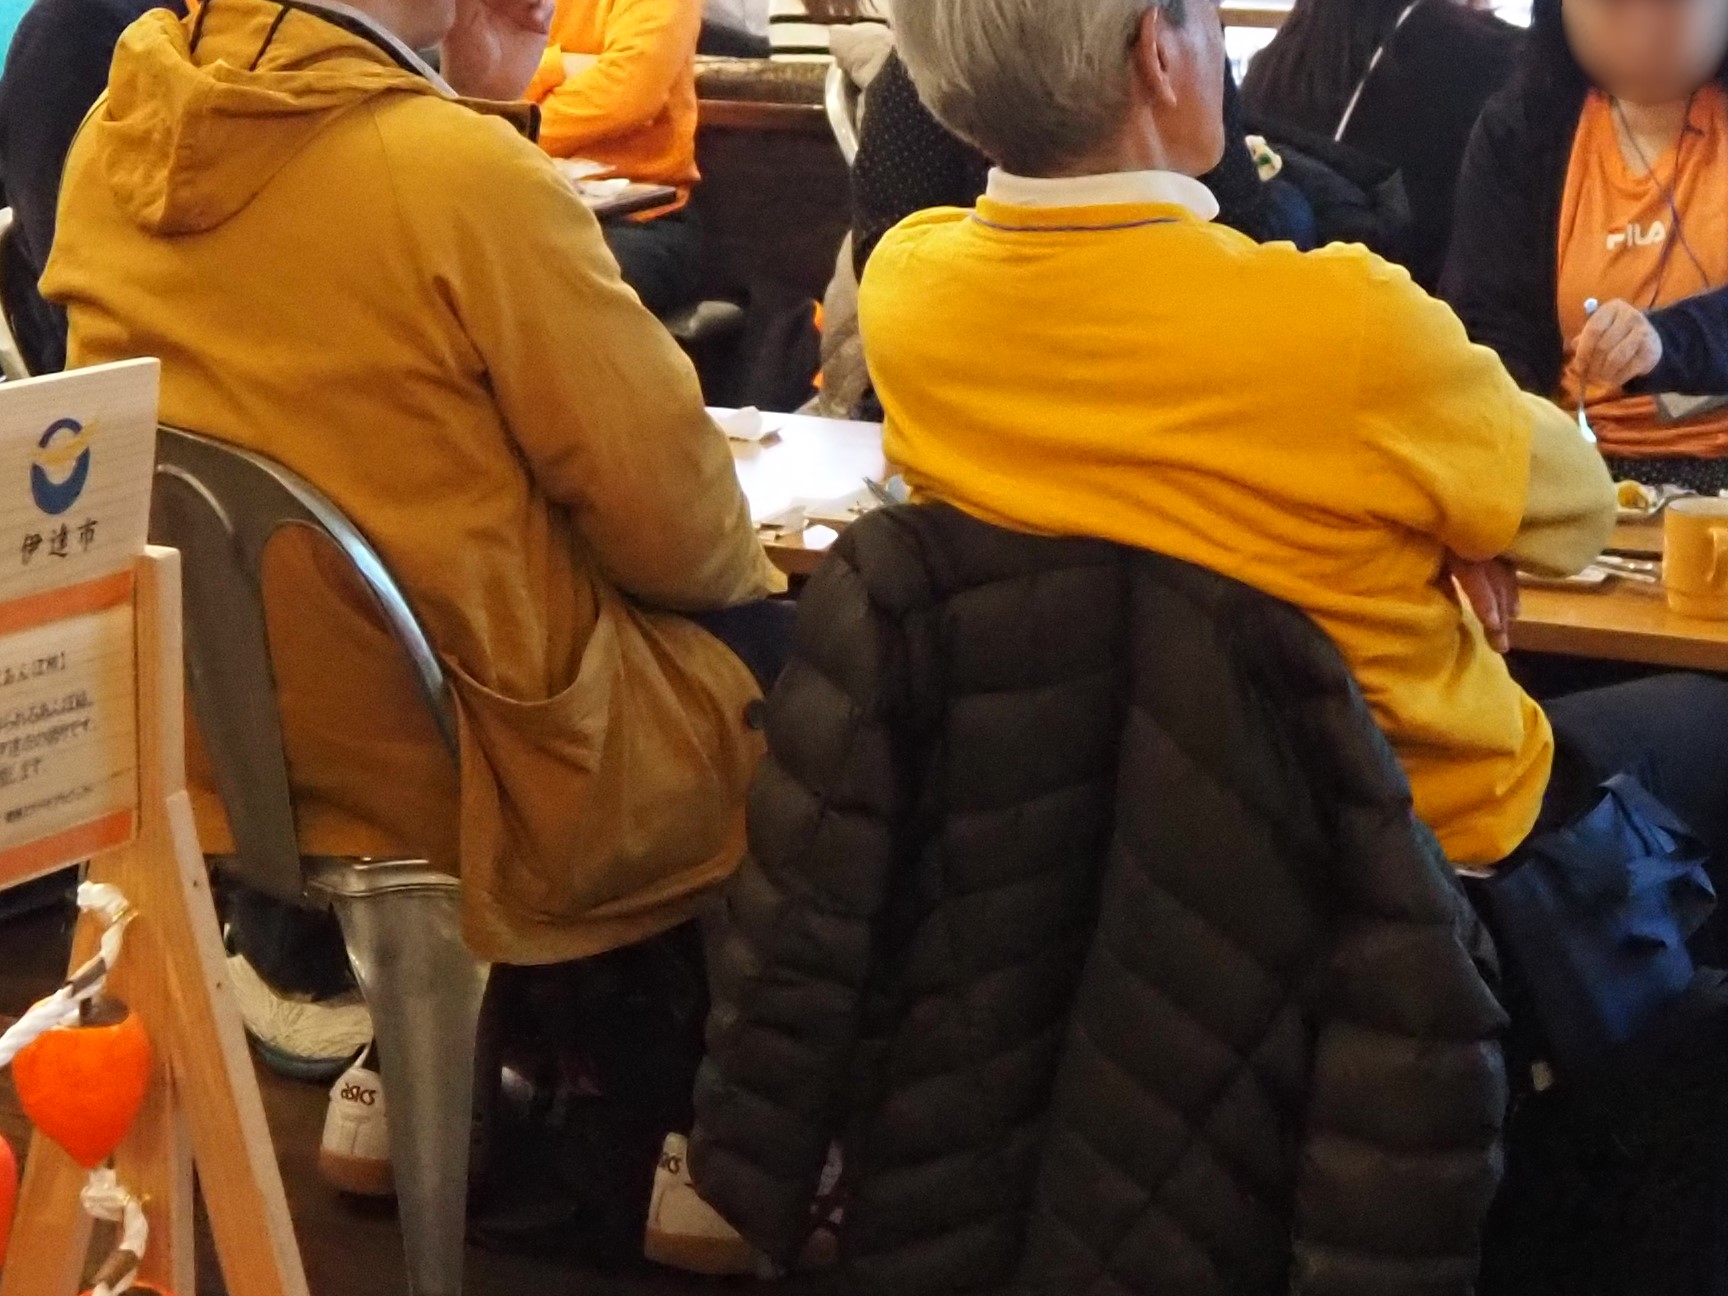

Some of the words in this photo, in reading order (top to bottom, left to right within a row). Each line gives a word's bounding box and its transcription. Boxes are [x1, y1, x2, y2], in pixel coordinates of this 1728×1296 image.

[1606, 220, 1666, 251] FILA
[21, 517, 99, 565] 伊達市
